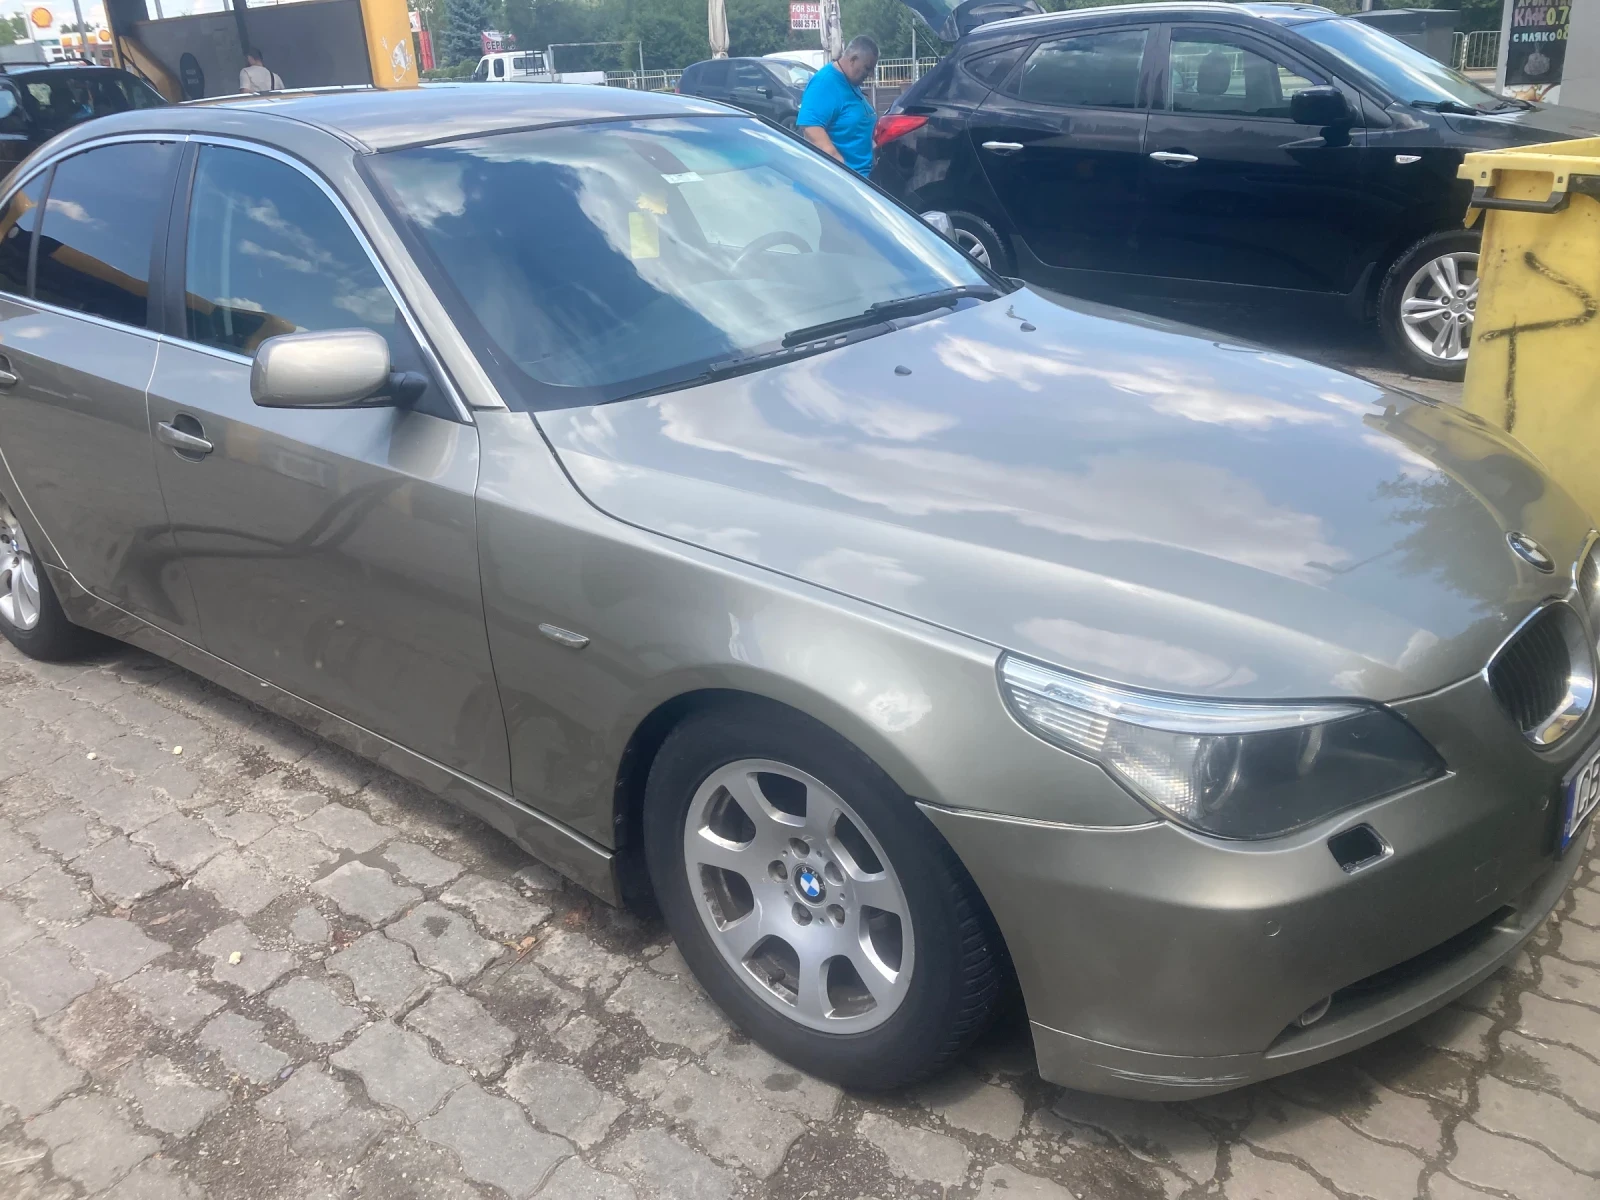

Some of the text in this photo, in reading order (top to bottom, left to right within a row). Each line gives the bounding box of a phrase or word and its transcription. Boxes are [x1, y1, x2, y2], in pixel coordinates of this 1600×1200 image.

[792, 4, 805, 12] FOR
[1514, 6, 1571, 26] КАФЕ 0.7
[1521, 31, 1556, 42] МЛЯКО
